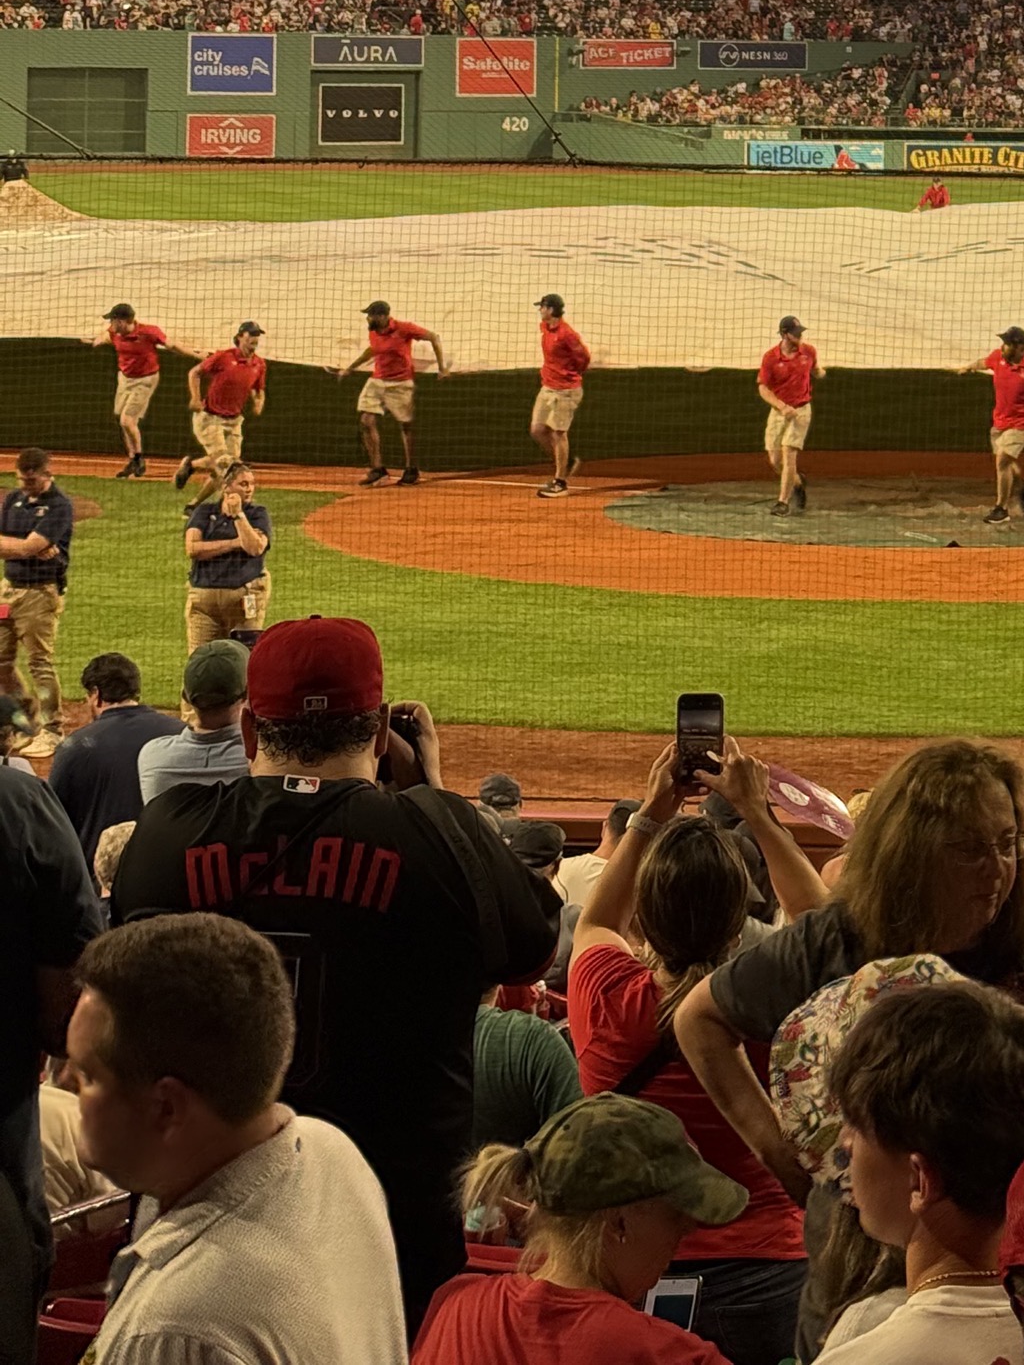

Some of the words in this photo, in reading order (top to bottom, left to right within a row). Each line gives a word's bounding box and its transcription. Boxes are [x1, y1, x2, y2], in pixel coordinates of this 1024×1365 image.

[194, 48, 222, 63] city
[620, 46, 672, 63] TICKET
[741, 50, 771, 61] NESN
[773, 50, 788, 61] 360
[193, 63, 248, 77] cruises
[325, 109, 399, 118] VOLVO
[501, 116, 529, 132] 420
[200, 128, 261, 144] IRVING
[756, 145, 824, 166] jetBlue
[909, 146, 994, 170] GRANITE
